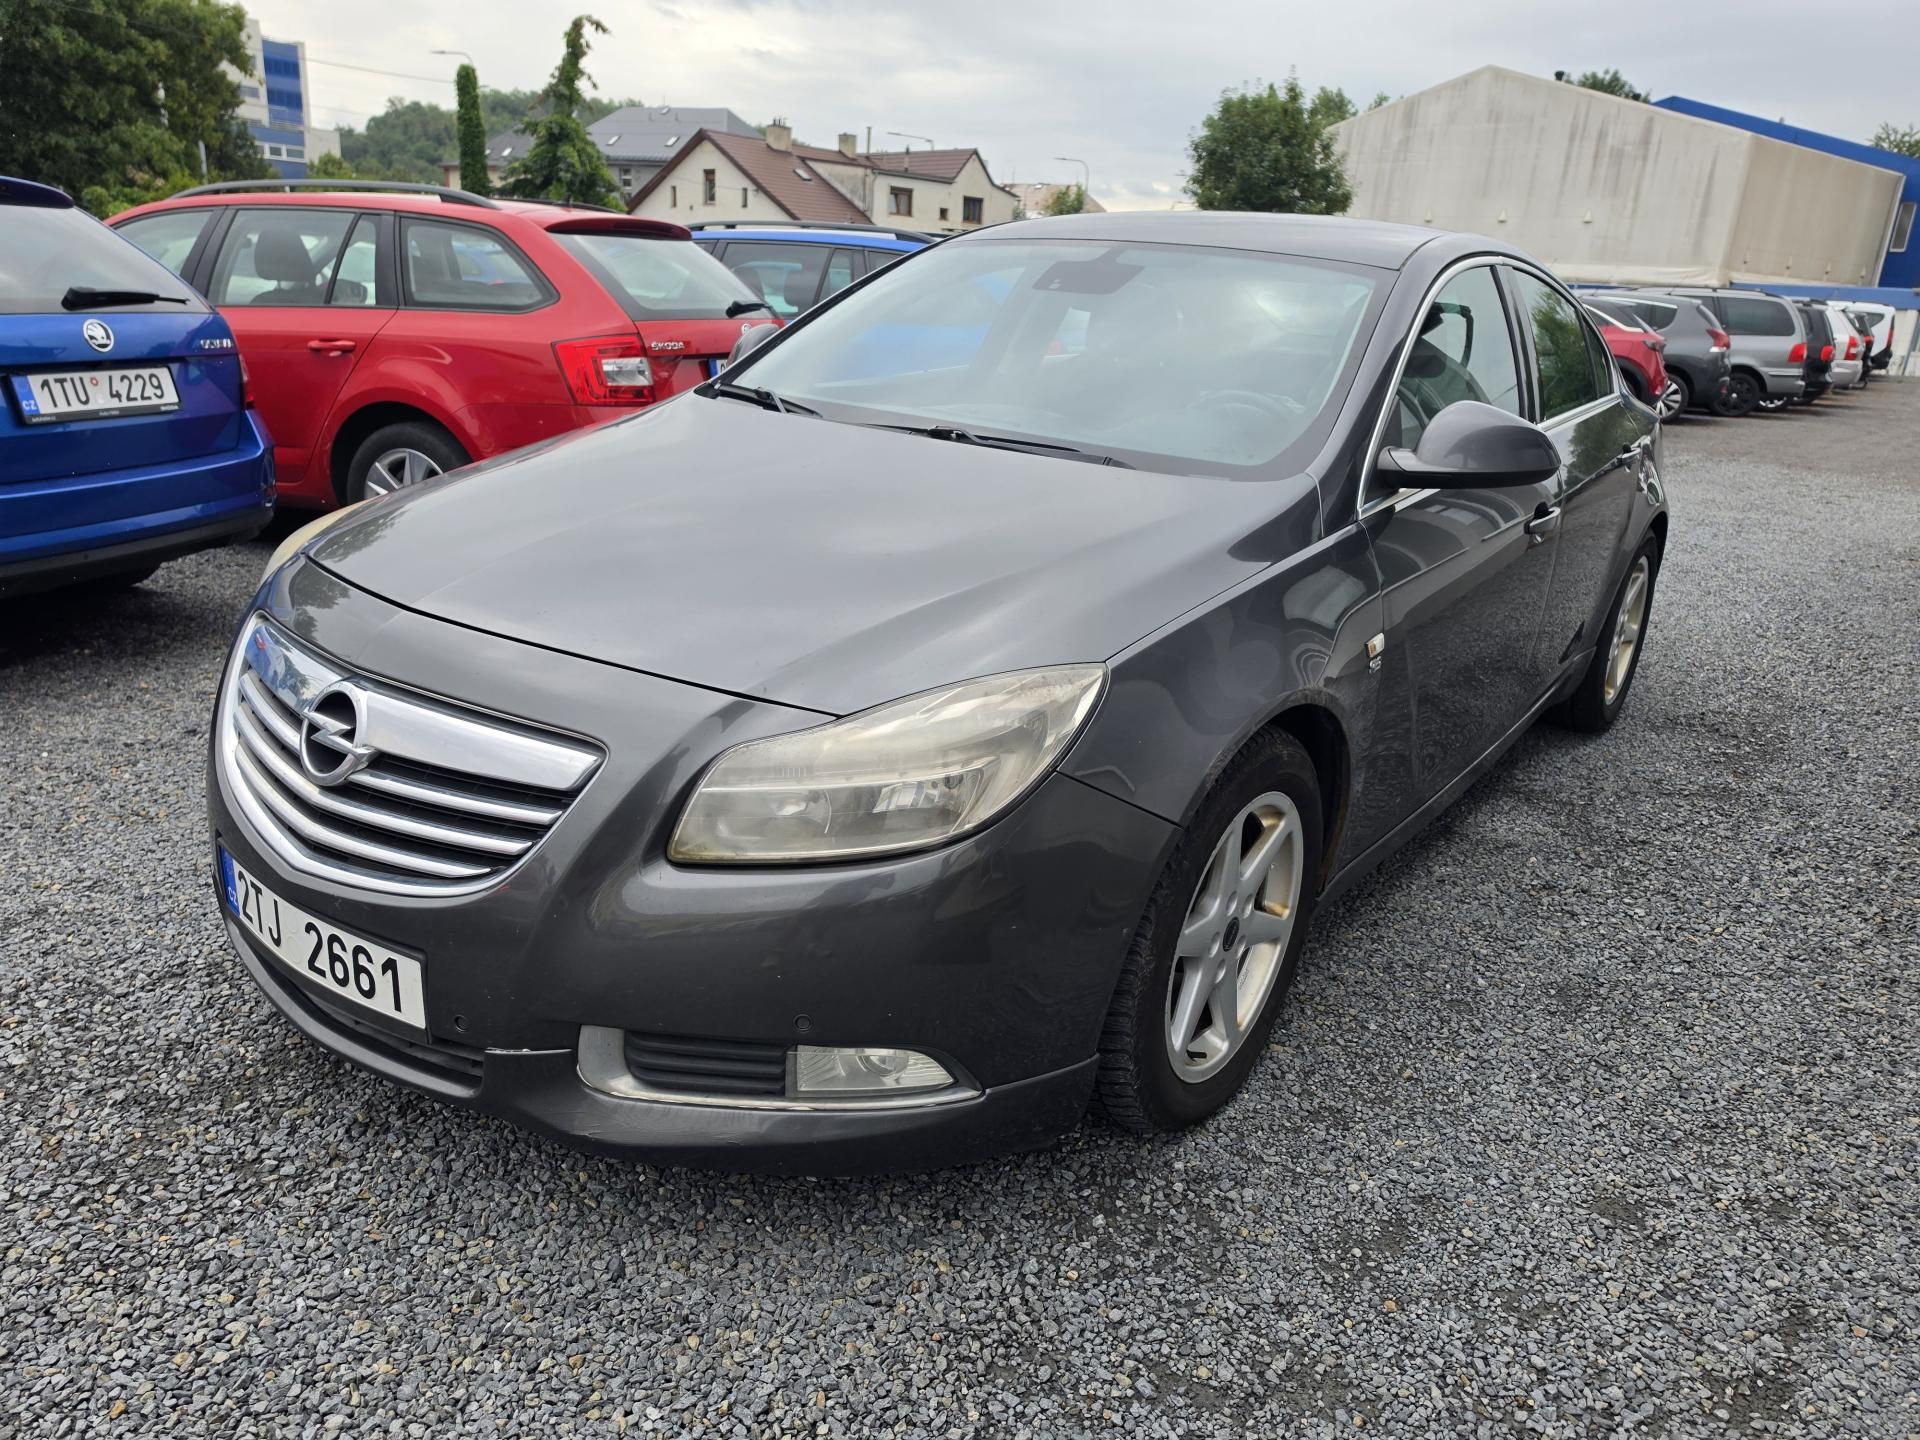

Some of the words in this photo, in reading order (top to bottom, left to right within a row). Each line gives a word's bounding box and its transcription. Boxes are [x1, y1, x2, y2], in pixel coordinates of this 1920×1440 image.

[22, 401, 38, 411] CZ
[41, 375, 90, 408] 1TU
[108, 373, 164, 403] 4229
[238, 870, 282, 948] 2TJ
[304, 922, 402, 1013] 2661
